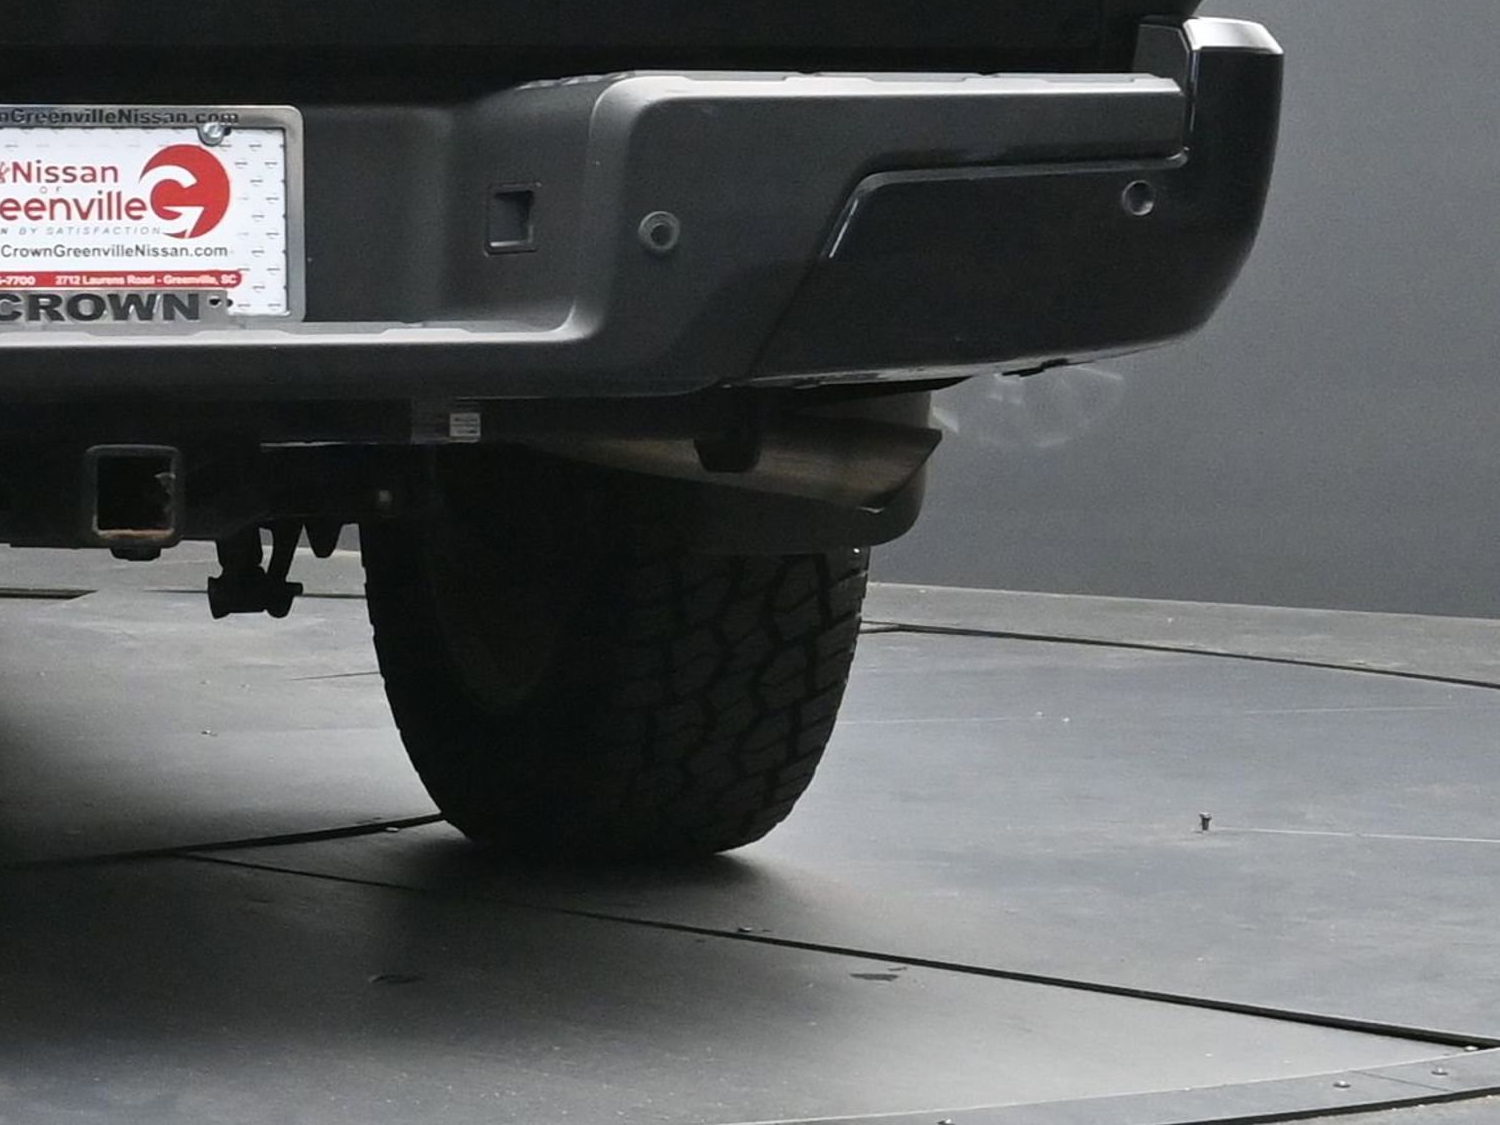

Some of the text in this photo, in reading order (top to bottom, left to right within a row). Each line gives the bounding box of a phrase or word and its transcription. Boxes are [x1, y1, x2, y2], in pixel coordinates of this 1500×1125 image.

[11, 159, 119, 184] Nissan
[19, 226, 38, 235] BY
[46, 226, 161, 236] SATISFACTION
